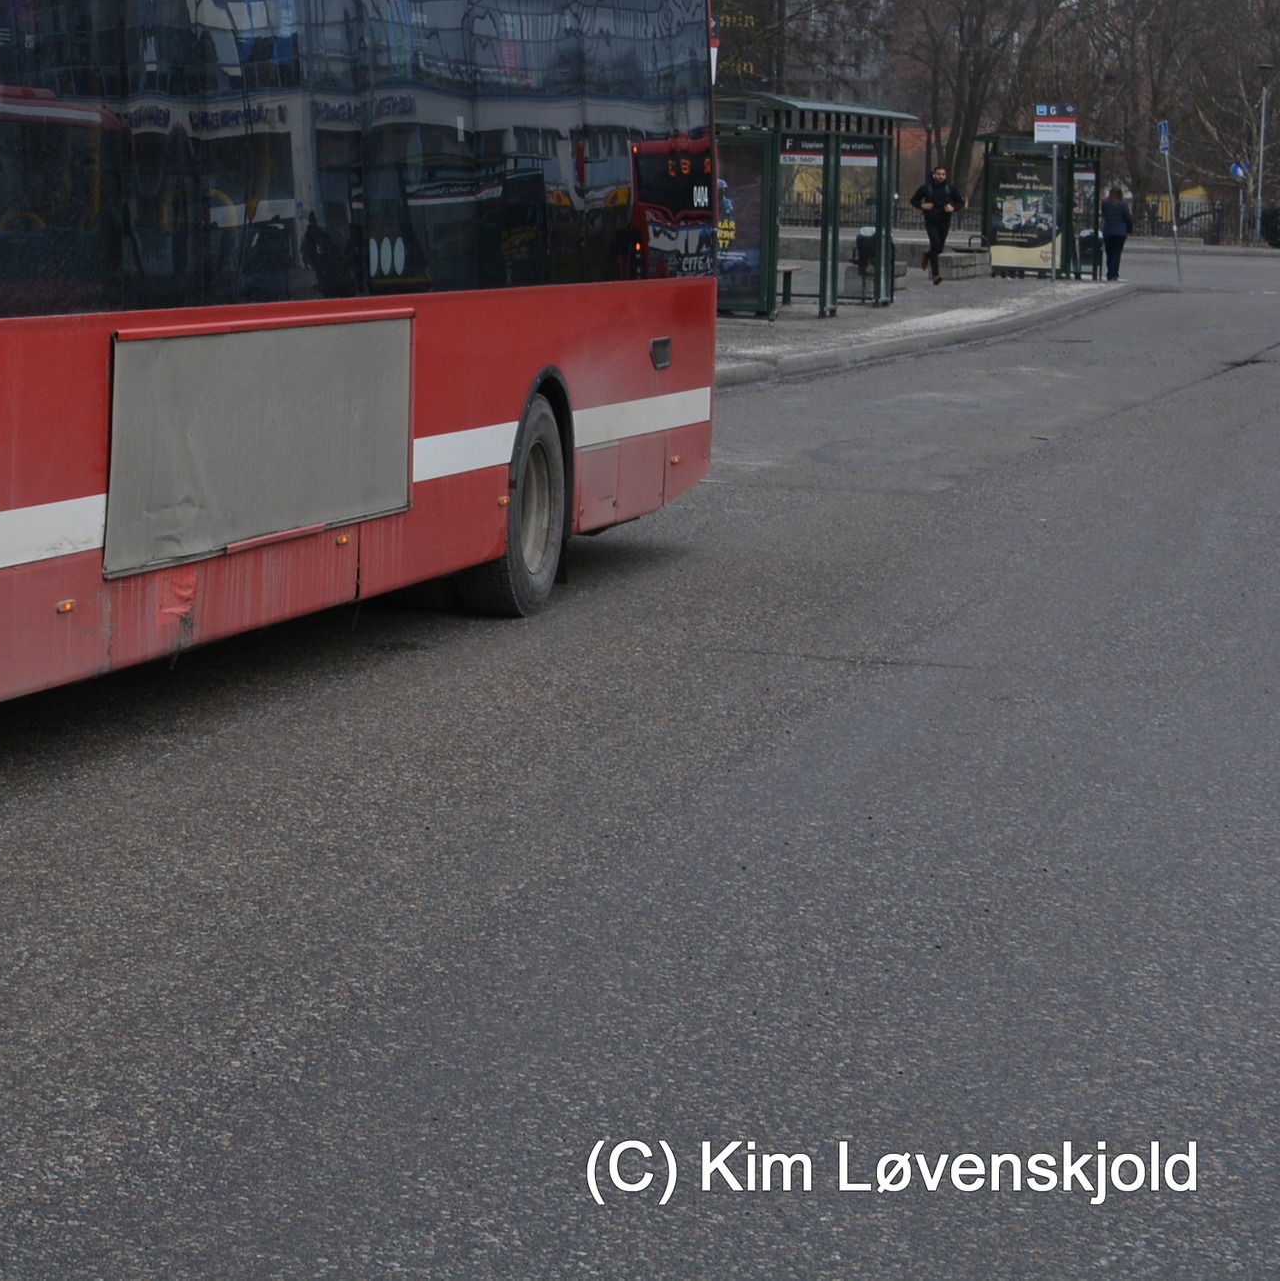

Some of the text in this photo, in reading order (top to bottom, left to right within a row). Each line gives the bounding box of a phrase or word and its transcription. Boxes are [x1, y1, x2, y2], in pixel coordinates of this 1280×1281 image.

[1050, 105, 1057, 116] G
[786, 139, 794, 150] F
[851, 142, 874, 150] station
